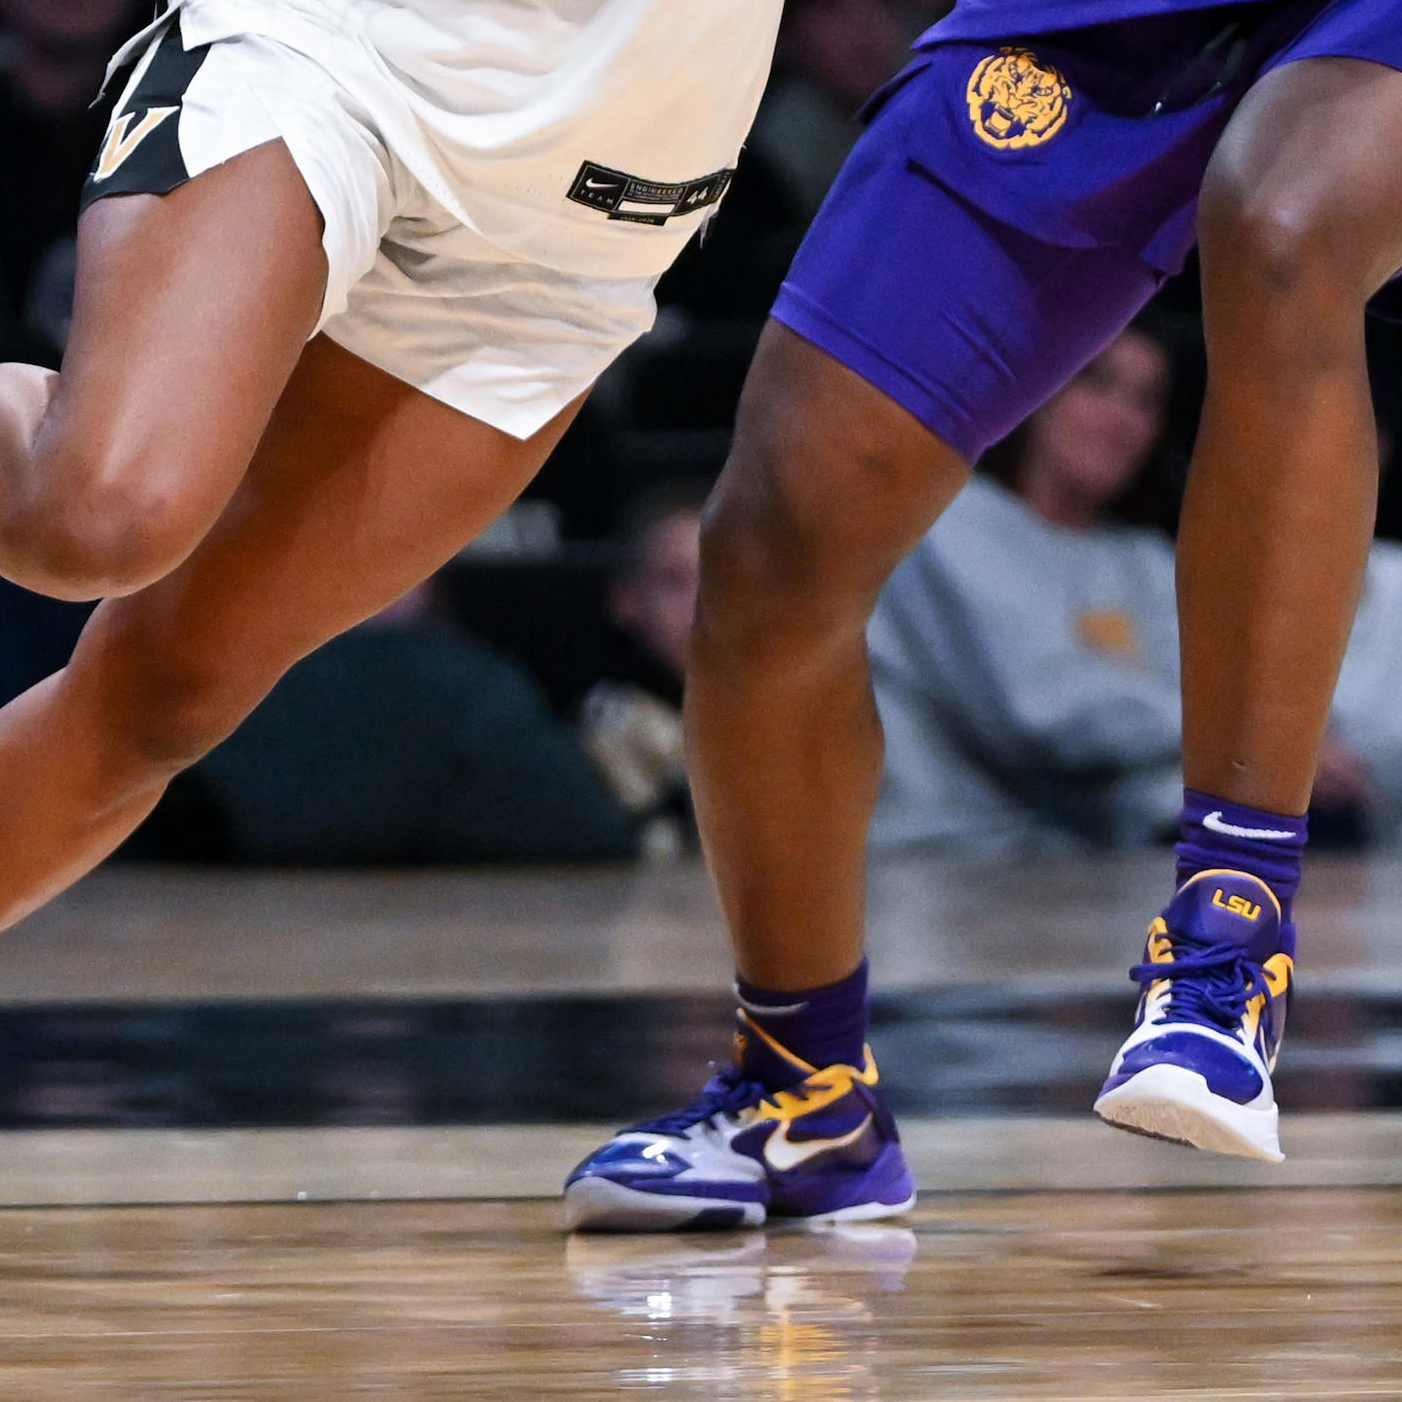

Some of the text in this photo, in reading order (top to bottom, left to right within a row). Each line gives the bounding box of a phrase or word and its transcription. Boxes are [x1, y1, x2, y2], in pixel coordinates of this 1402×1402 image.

[93, 106, 180, 182] V
[580, 189, 614, 205] TEAM
[686, 186, 709, 204] 44
[1211, 888, 1262, 921] LSU
